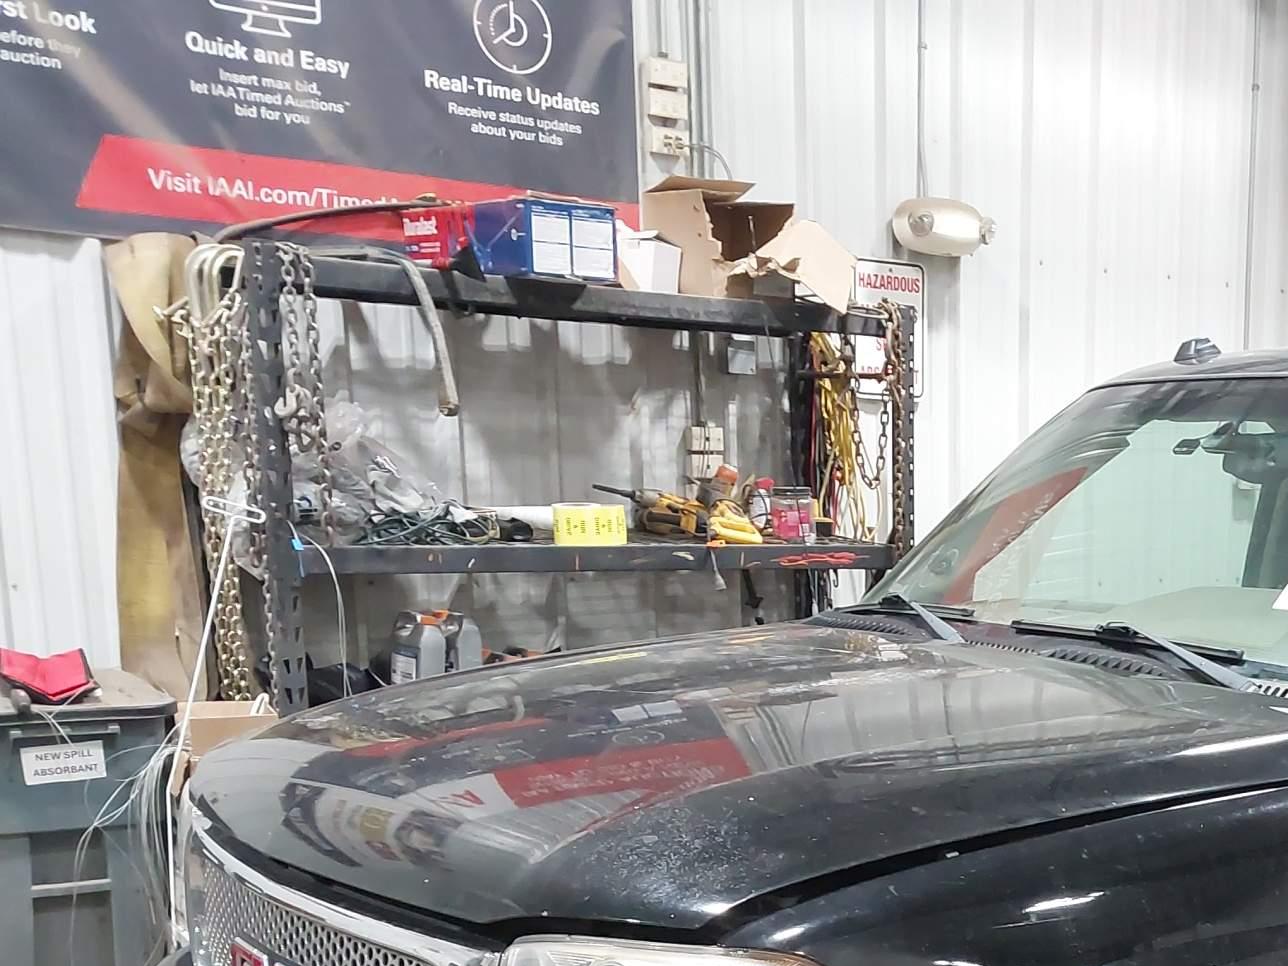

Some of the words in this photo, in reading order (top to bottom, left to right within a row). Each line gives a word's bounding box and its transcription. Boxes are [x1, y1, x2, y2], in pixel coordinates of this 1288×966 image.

[33, 2, 97, 34] Look
[0, 49, 62, 69] auction
[185, 31, 248, 61] Quick
[253, 47, 294, 68] and
[300, 49, 350, 79] Easy
[189, 80, 209, 95] let
[211, 82, 237, 99] IAA
[237, 87, 282, 106] Timed
[219, 68, 259, 87] Insert
[262, 76, 291, 91] max
[295, 80, 322, 97] bid,
[424, 69, 523, 102] Real-Time
[526, 86, 600, 116] Updates
[234, 104, 257, 118] bid
[260, 107, 282, 121] for
[283, 111, 311, 125] you
[448, 102, 497, 120] Receive
[499, 111, 535, 127] status
[536, 117, 583, 135] updates
[471, 122, 507, 138] about
[509, 128, 536, 141] your
[538, 131, 564, 146] bids
[147, 168, 202, 195] Visit
[858, 272, 920, 294] HAZARDOUS
[34, 751, 61, 761] NEW
[63, 747, 95, 759] SPILL
[33, 763, 98, 777] ABSORBANT
